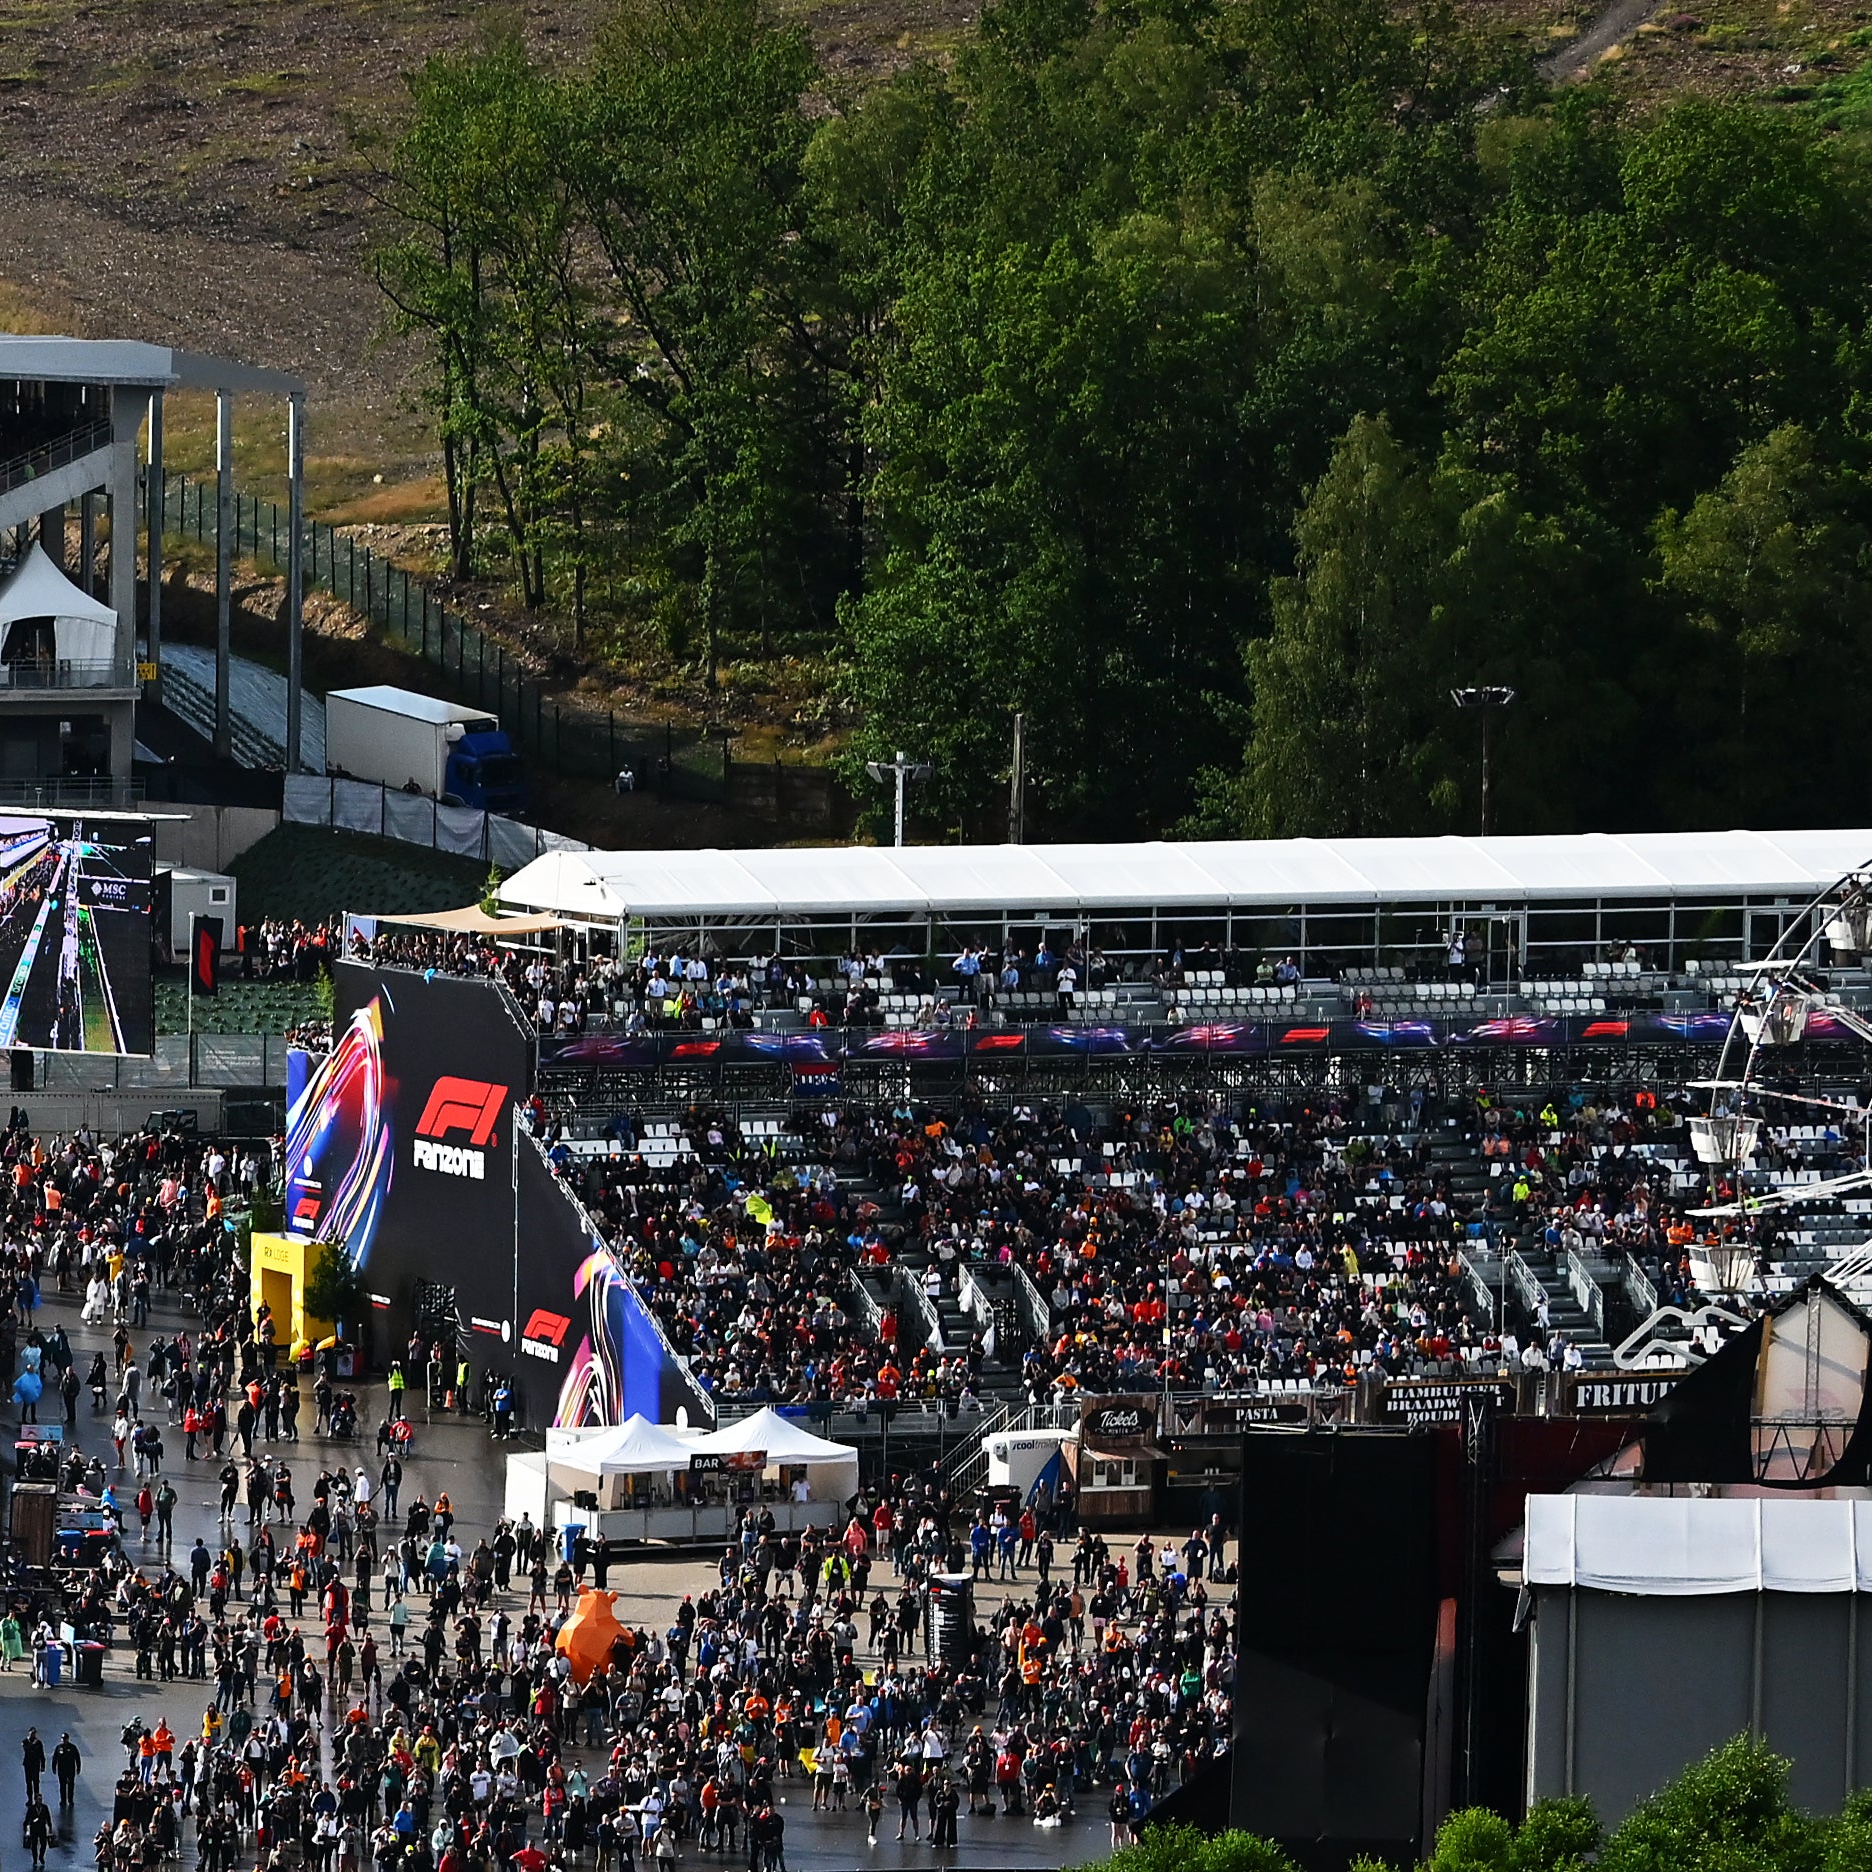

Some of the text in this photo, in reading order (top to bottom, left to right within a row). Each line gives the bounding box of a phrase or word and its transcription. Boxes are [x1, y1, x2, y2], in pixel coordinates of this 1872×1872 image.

[102, 884, 127, 895] MSC
[1099, 1409, 1140, 1430] Tickets
[1235, 1407, 1279, 1421] PASTA
[694, 1457, 719, 1470] BAR
